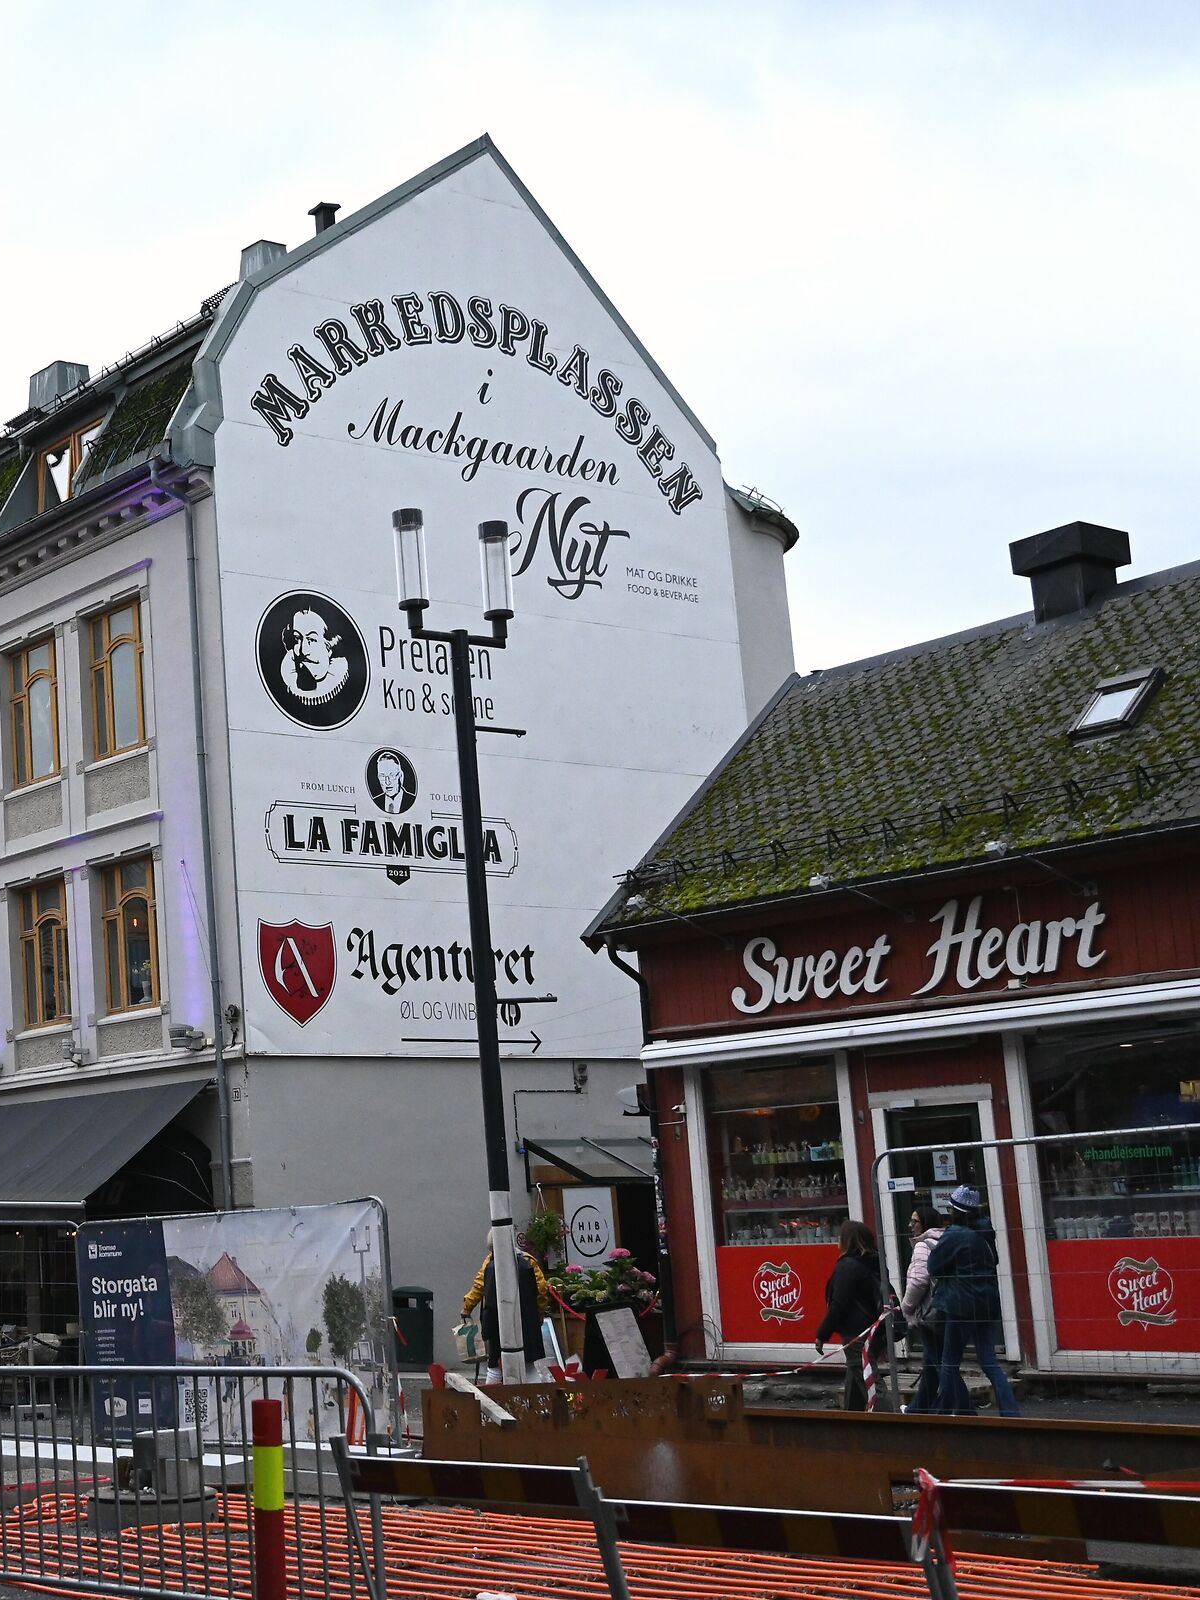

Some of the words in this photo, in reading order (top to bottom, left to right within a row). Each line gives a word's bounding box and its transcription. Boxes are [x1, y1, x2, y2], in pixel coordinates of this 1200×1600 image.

[476, 368, 492, 405] i
[250, 290, 703, 515] MARKEDSPLASSEN
[347, 396, 621, 485] Mackgaarden
[509, 487, 630, 600] Nyt
[626, 567, 645, 578] MAT
[647, 570, 663, 582] OG
[665, 573, 698, 588] DRIKKE
[627, 583, 652, 595] FOOD
[653, 588, 659, 597] &
[660, 588, 699, 604] BEVERAGE
[379, 625, 492, 680] Prelaen
[383, 678, 416, 712] Kro
[422, 682, 436, 714] &
[441, 692, 494, 720] sne
[301, 782, 324, 792] FROM
[327, 783, 356, 794] LUNCH
[430, 793, 441, 801] TO
[283, 813, 331, 852] LA
[340, 818, 503, 865] FAMIGLA
[388, 869, 408, 878] 2021
[732, 933, 891, 1015] Sweet
[911, 895, 1107, 997] Heart
[400, 1001, 420, 1020] ØL
[422, 1001, 443, 1020] OG
[447, 1002, 488, 1021] VINB
[578, 1220, 600, 1231] HIB
[579, 1233, 602, 1244] ANA
[91, 1275, 158, 1298] Storgata
[760, 1273, 791, 1299] Sweet
[1117, 1271, 1159, 1300] Sweet
[93, 1299, 117, 1319] blir
[121, 1298, 145, 1322] ny!
[770, 1287, 798, 1309] Heart
[1131, 1287, 1169, 1311] Heart
